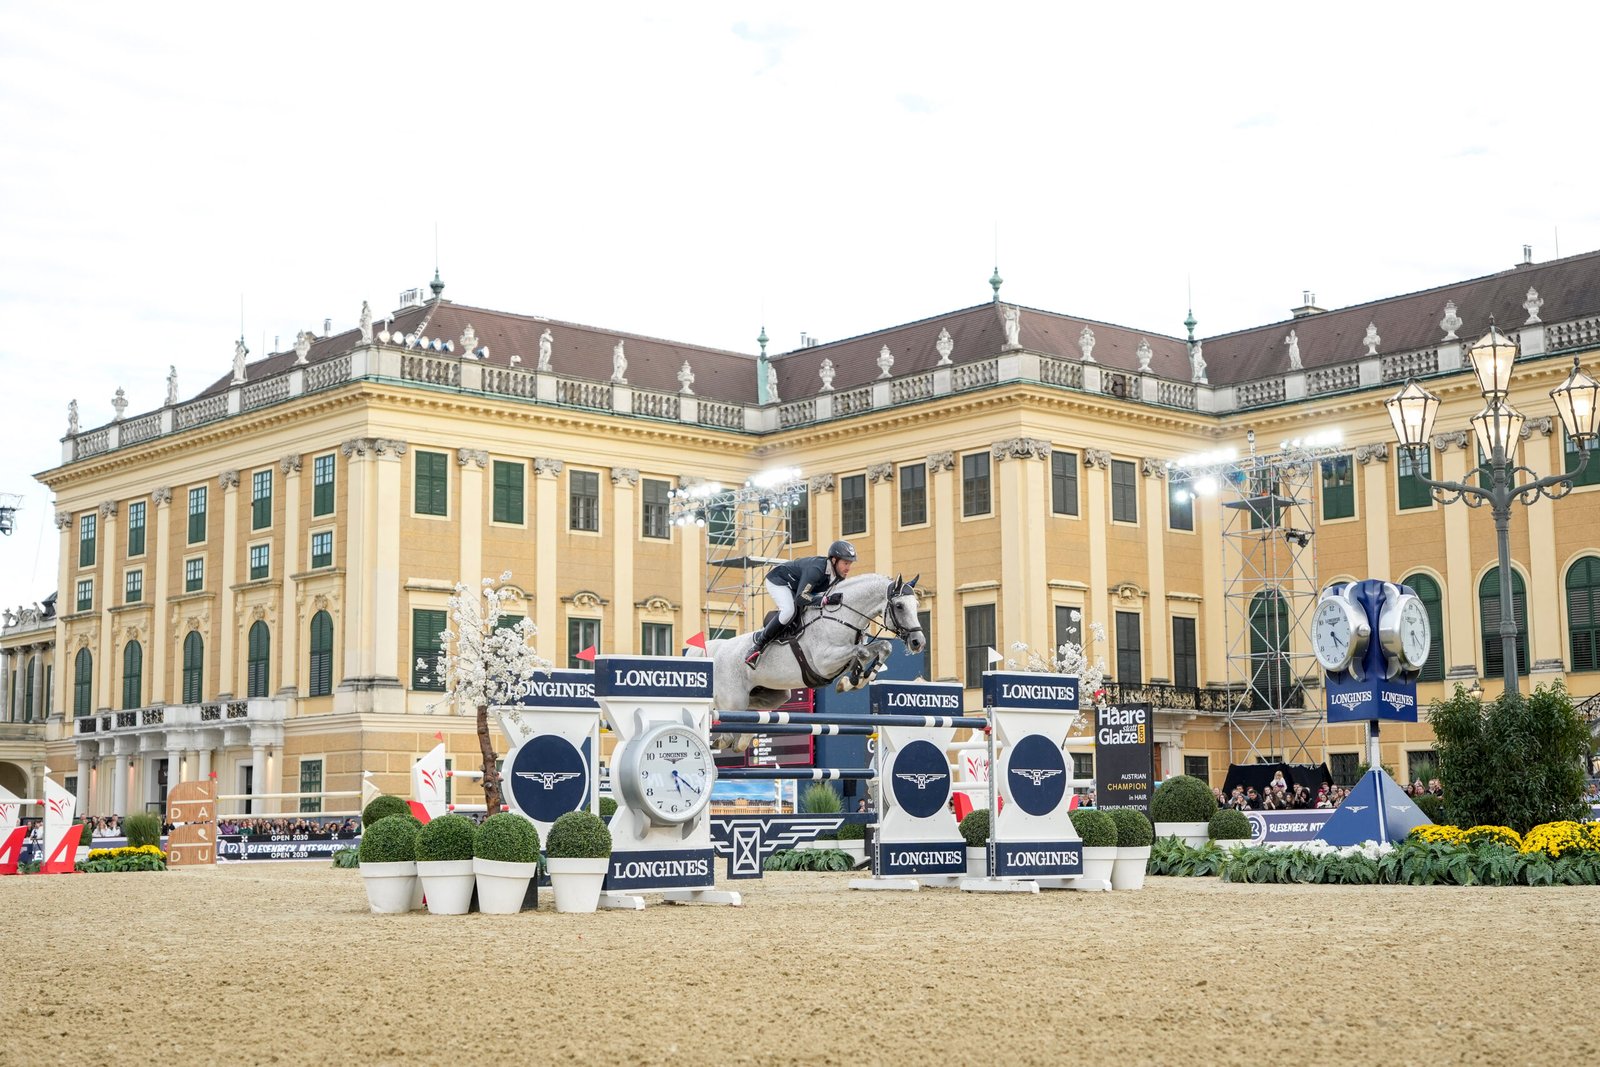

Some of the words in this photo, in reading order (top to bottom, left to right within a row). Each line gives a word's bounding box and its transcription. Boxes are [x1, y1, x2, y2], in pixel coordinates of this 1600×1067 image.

[614, 669, 708, 688] LONGINES
[506, 682, 595, 699] LONGINES
[1002, 684, 1075, 700] LONGINES
[1331, 690, 1372, 705] LONGINES
[1381, 690, 1414, 706] LONGINES
[887, 692, 959, 709] LONGINES
[1098, 706, 1146, 726] Haare
[656, 740, 663, 748] 11
[668, 735, 678, 743] 12
[1098, 728, 1138, 745] Glatze
[641, 770, 649, 779] 9
[698, 768, 705, 777] 3
[646, 788, 654, 796] 8
[1107, 782, 1147, 791] CHAMPION
[657, 801, 663, 809] 7
[889, 850, 962, 866] LONGINES
[1006, 851, 1079, 867] LONGINES
[613, 859, 708, 879] LONGINES
